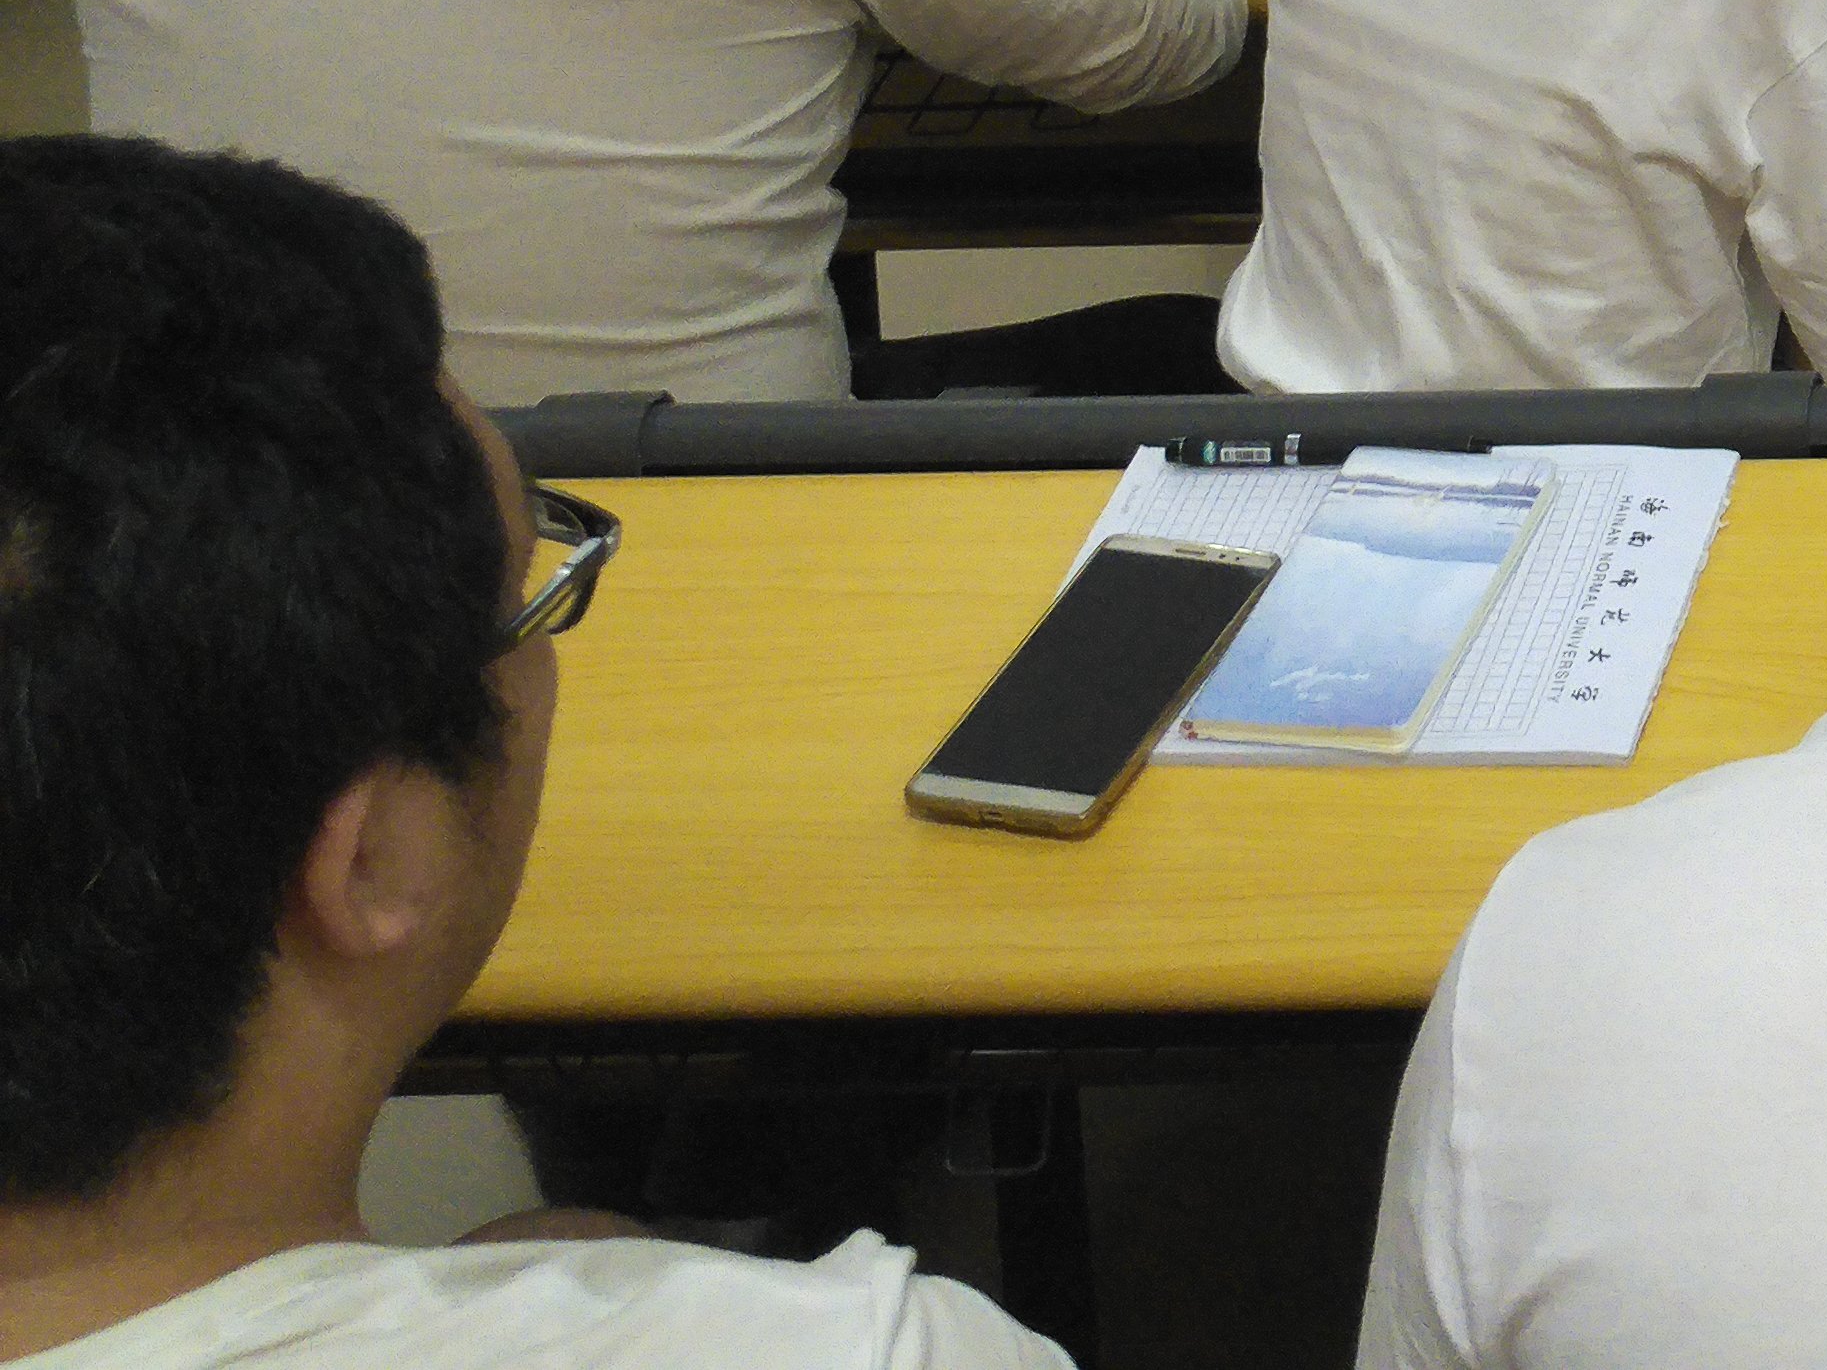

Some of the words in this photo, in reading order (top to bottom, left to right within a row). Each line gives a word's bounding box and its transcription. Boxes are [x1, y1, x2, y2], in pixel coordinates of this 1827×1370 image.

[1605, 494, 1634, 546] HAINAN
[1580, 551, 1614, 610] NORMAL
[1546, 616, 1590, 704] UNIVERSITY
